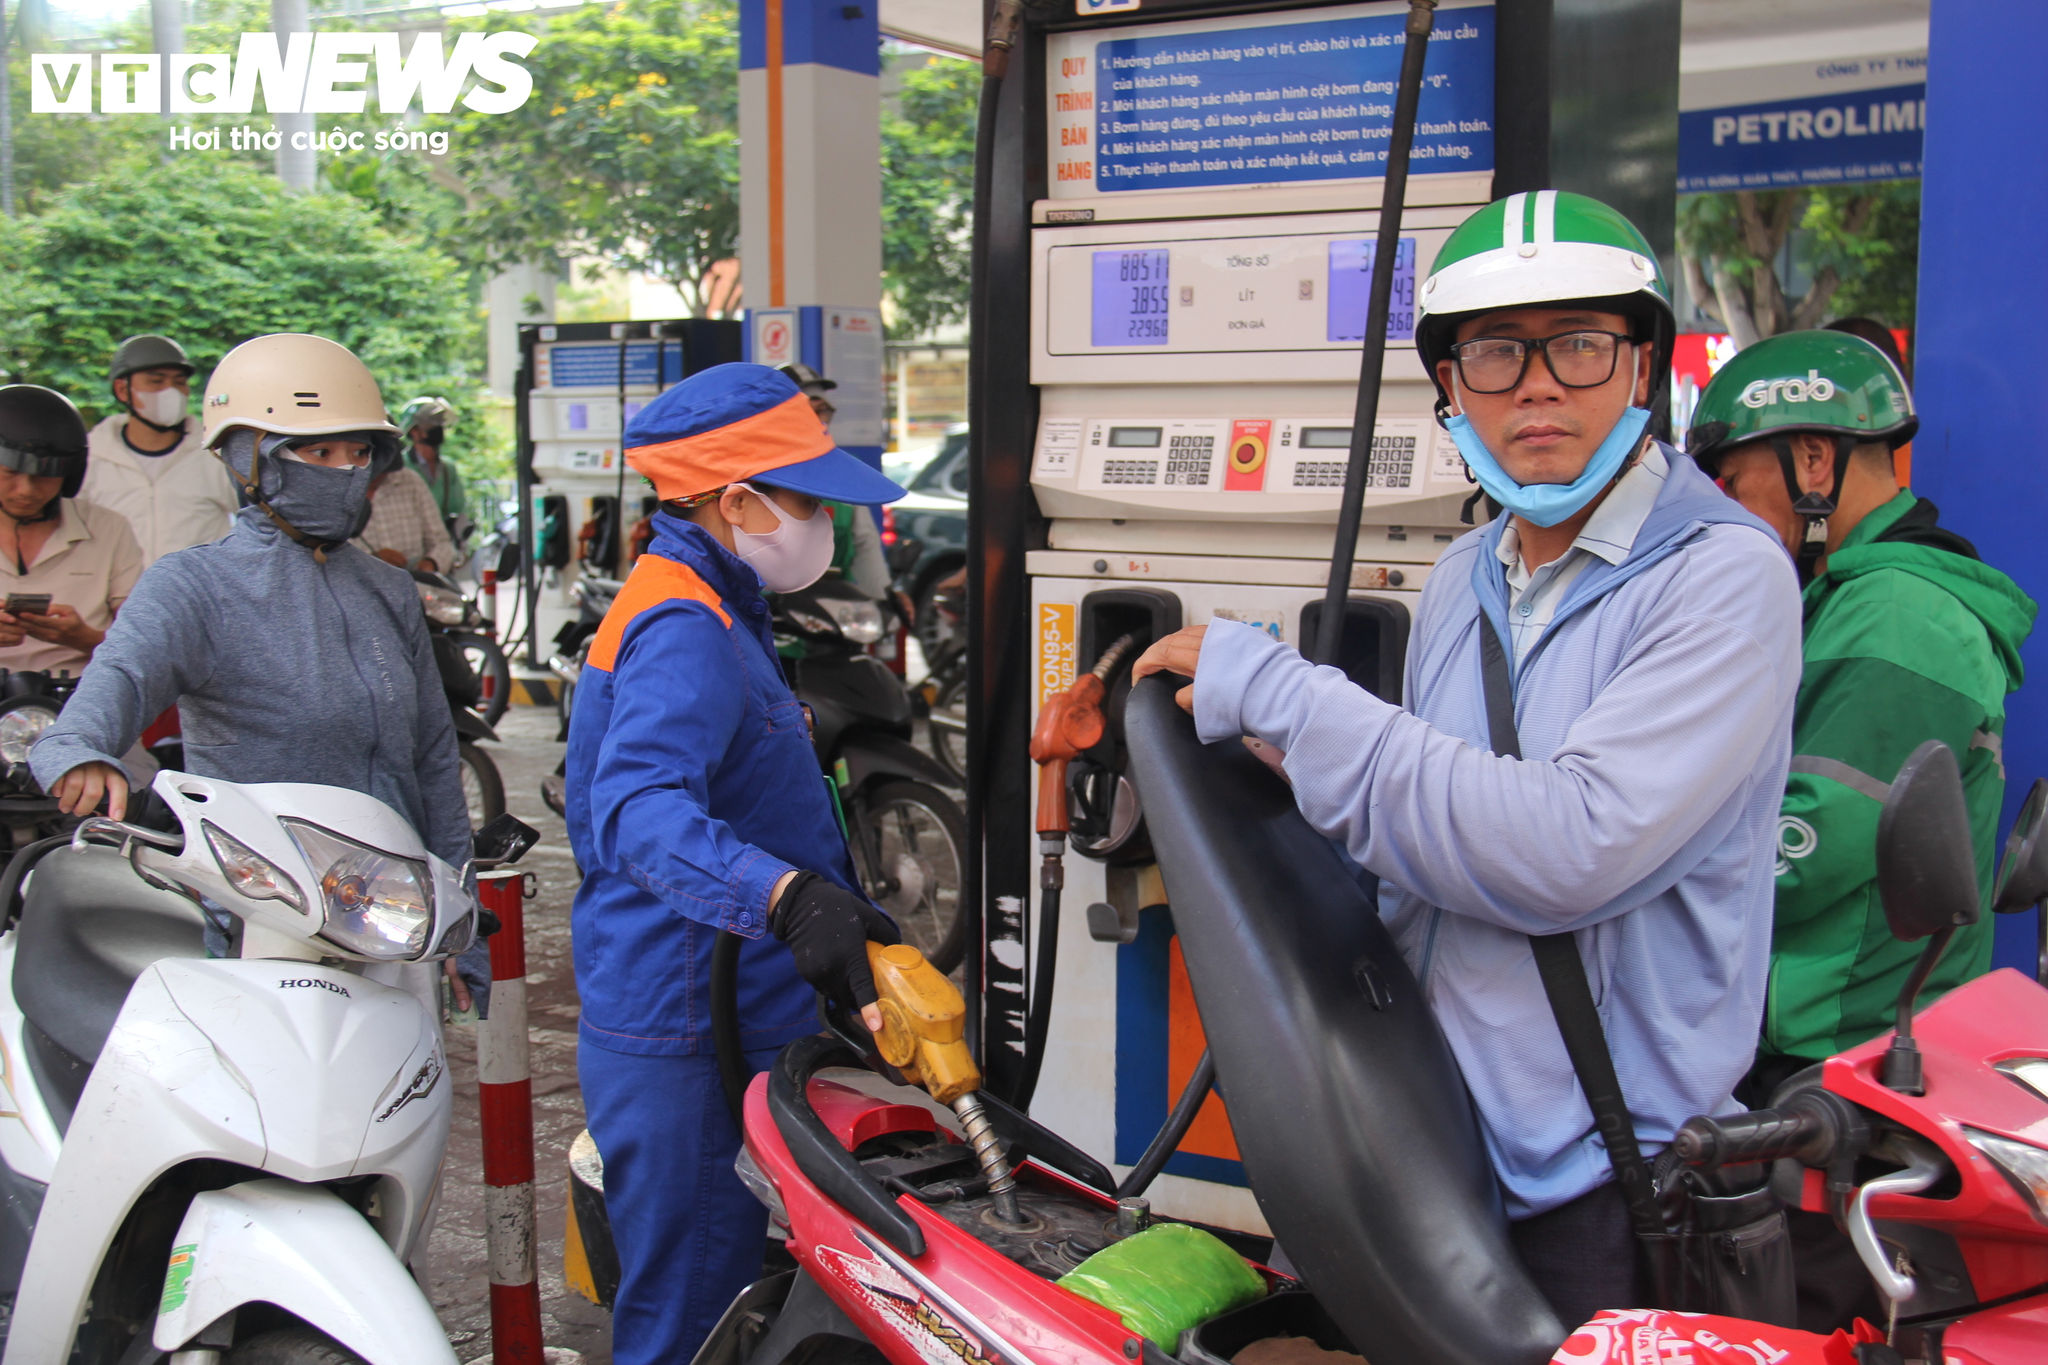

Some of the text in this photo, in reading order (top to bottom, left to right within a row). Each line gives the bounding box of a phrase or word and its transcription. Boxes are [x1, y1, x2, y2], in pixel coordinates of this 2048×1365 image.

[1102, 58, 1111, 70] 1.
[1153, 52, 1174, 66] dẫn
[1176, 50, 1210, 63] khách
[1213, 48, 1241, 62] hàng
[1244, 45, 1264, 57] vào
[1267, 43, 1278, 58] vị
[1299, 38, 1328, 53] chào
[1330, 36, 1350, 50] hỏi
[1352, 34, 1367, 48] và
[1369, 32, 1391, 47] xác
[1455, 22, 1478, 39] cầu
[1062, 57, 1086, 78] QUY
[1868, 62, 1887, 73] TY
[1897, 57, 1927, 70] TNH
[1112, 72, 1202, 90] của khách hàng.
[1055, 90, 1093, 112] TRÌNH
[1101, 101, 1110, 113] 2.
[1113, 98, 1134, 112] Mời
[1136, 96, 1169, 111] khách
[1171, 94, 1199, 109] hàng
[1201, 92, 1221, 105] xác
[1224, 90, 1252, 106] nhận
[1255, 88, 1280, 102] màn
[1282, 84, 1308, 99] hình
[1311, 83, 1330, 100] cột
[1332, 81, 1360, 96] bơm
[1363, 79, 1393, 95] đang
[1101, 123, 1110, 134] 3.
[1113, 121, 1139, 133] Bơm
[1142, 118, 1169, 133] hàng
[1205, 112, 1220, 127] đủ
[1222, 112, 1247, 126] theo
[1250, 110, 1270, 127] yêu
[1273, 107, 1294, 122] cầu
[1297, 105, 1318, 120] của
[1321, 104, 1357, 119] khách
[1360, 102, 1393, 118] hàng.
[1061, 125, 1088, 147] BÁN
[1101, 145, 1110, 156] 4.
[1113, 141, 1134, 155] Mời
[1136, 140, 1169, 154] khách
[1171, 137, 1199, 153] hàng
[1201, 136, 1221, 149] xác
[1224, 134, 1252, 150] nhận
[1255, 132, 1280, 146] màn
[1282, 130, 1308, 144] hình
[1310, 129, 1330, 144] cột
[1332, 127, 1360, 141] bơm
[1362, 124, 1393, 139] trướ
[1421, 120, 1456, 135] thanh
[1459, 118, 1491, 133] toán.
[1057, 158, 1092, 181] HÀNG
[1101, 165, 1111, 177] 5.
[1114, 163, 1141, 178] Thực
[1143, 161, 1168, 176] hiện
[1169, 159, 1200, 173] thanh
[1203, 157, 1228, 171] toán
[1230, 156, 1244, 169] và
[1246, 155, 1267, 169] xác
[1269, 153, 1298, 169] nhận
[1300, 150, 1319, 165] kết
[1438, 143, 1473, 159] hàng.
[1226, 253, 1270, 268] TỔNG SỐ
[1238, 288, 1255, 301] LÍT
[1128, 318, 1169, 338] 22960
[1228, 318, 1266, 330] ĐƠN GIÁ
[1742, 369, 1835, 409] Grab
[279, 979, 351, 999] HONDA
